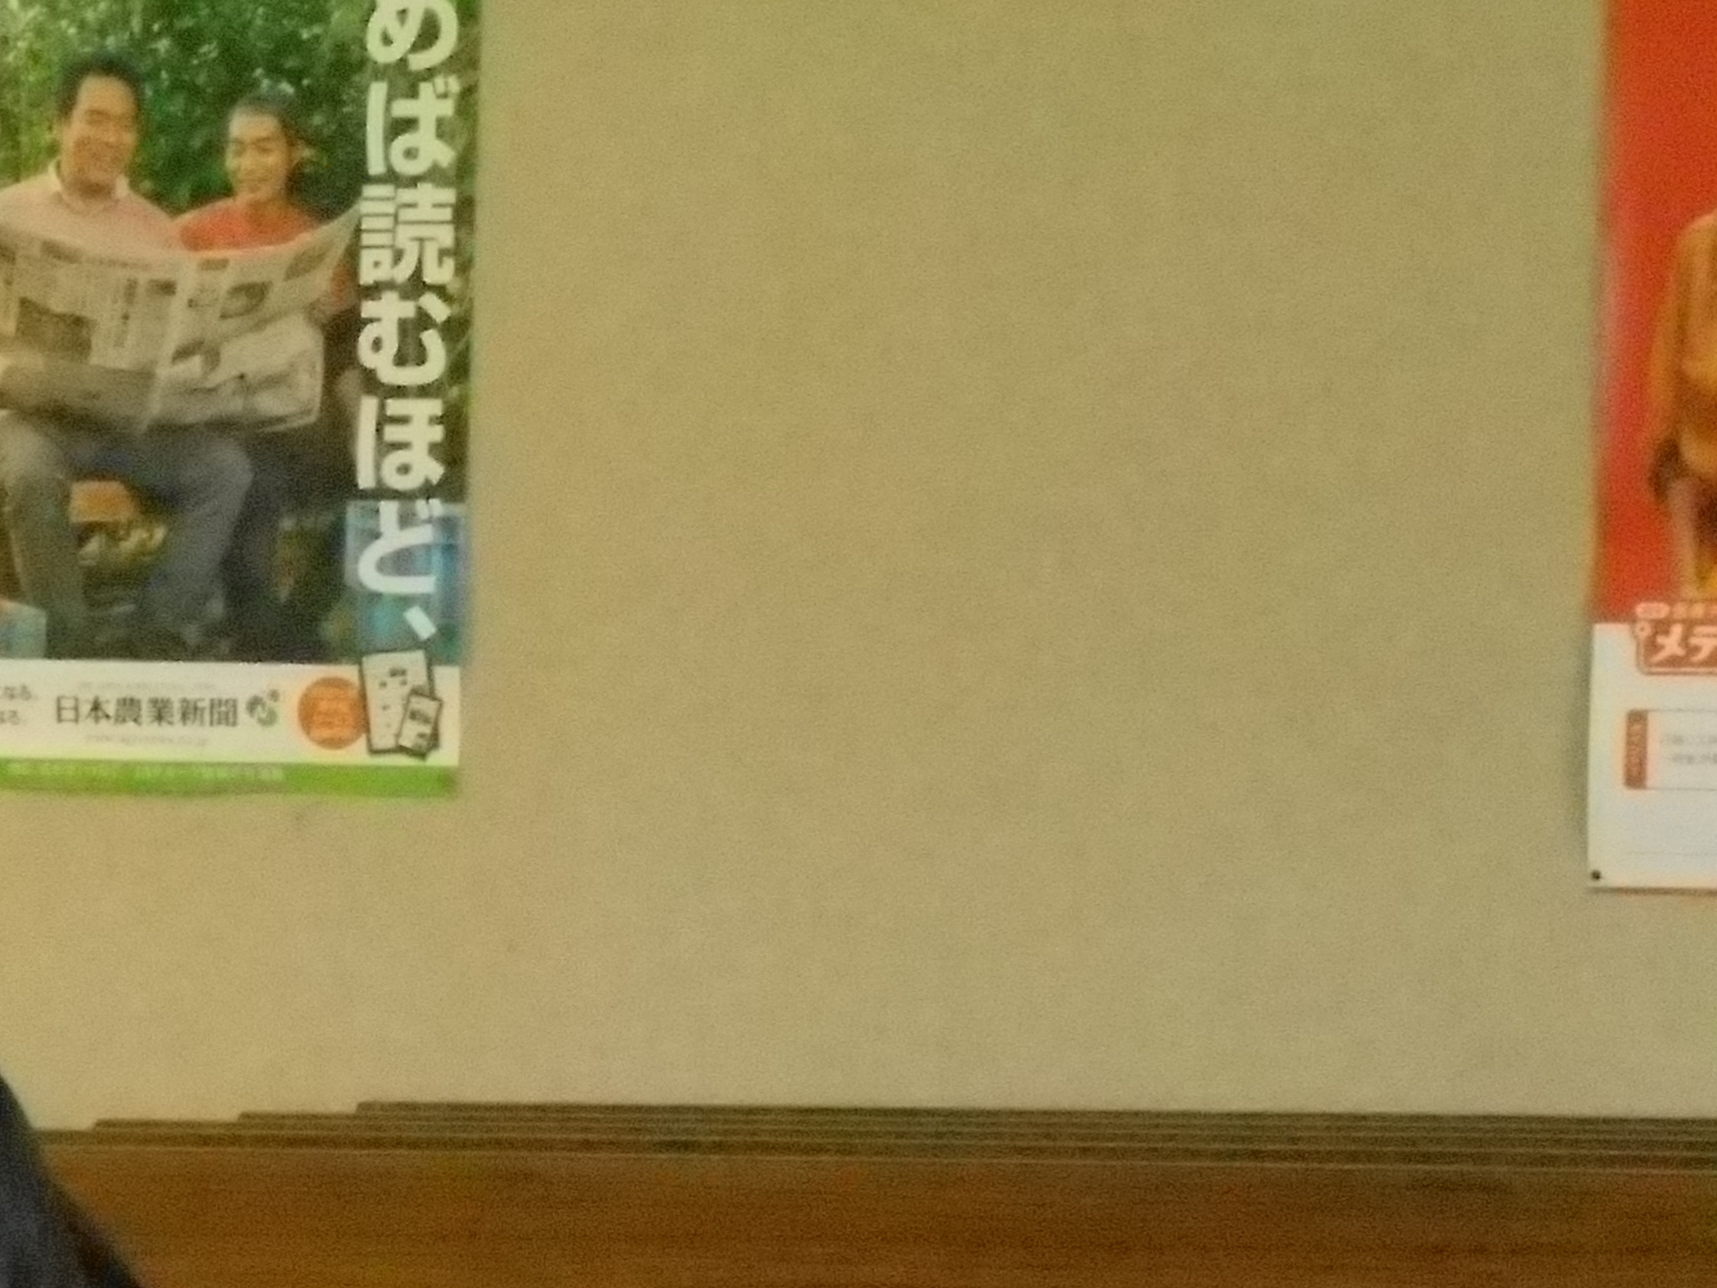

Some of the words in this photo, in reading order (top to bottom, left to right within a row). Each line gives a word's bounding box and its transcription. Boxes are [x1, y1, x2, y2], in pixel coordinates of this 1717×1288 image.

[356, 0, 462, 641] めば読むほど、
[55, 695, 239, 728] 日本農業新聞
